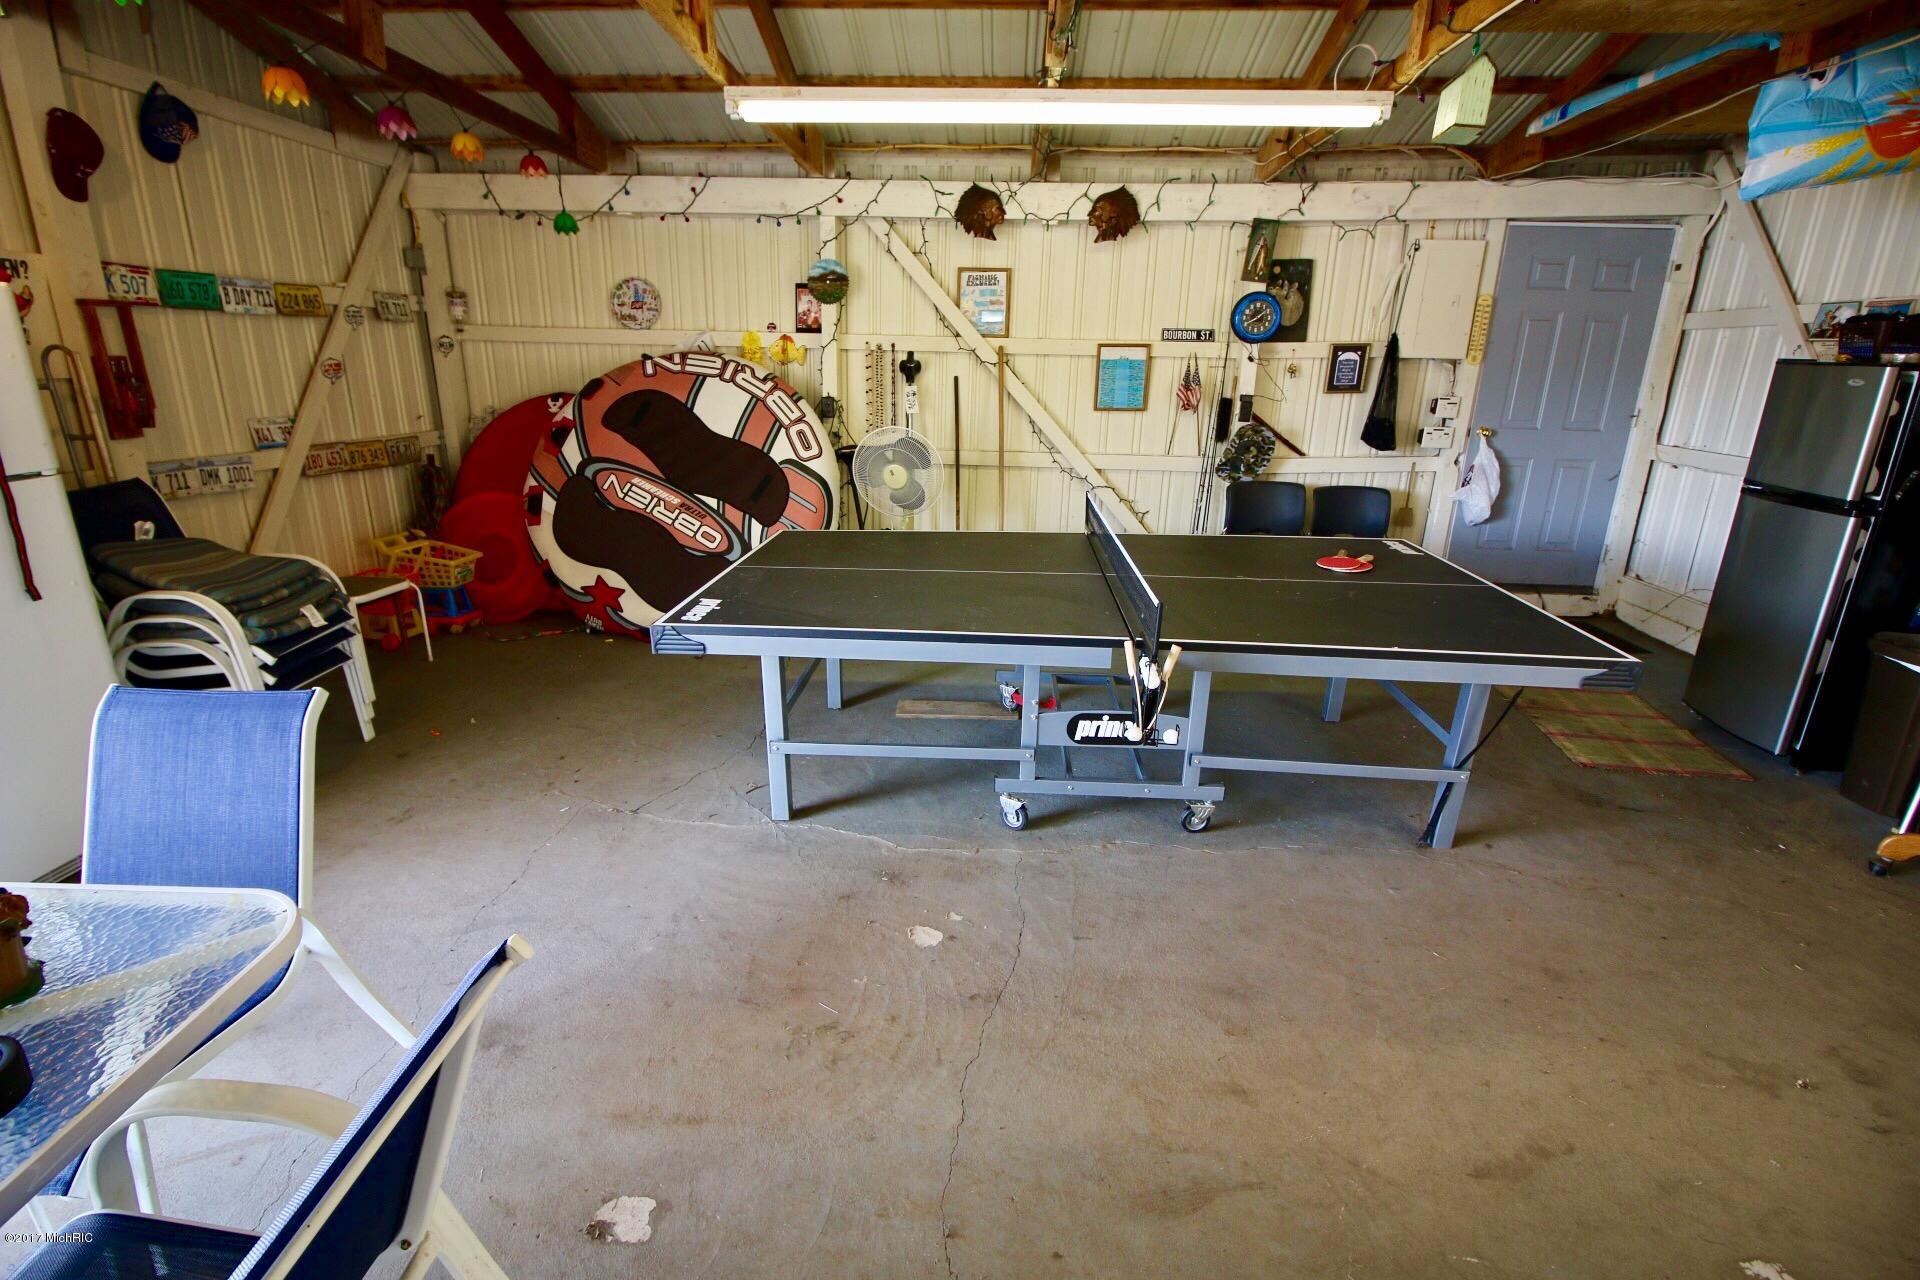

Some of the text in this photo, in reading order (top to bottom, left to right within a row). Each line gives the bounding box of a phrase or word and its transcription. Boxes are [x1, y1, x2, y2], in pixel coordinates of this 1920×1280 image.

[119, 274, 148, 295] 507
[222, 286, 274, 308] B DAY 711
[279, 292, 321, 310] 224 865
[392, 302, 408, 317] 711
[1163, 330, 1213, 340] BOURBON ST.
[165, 471, 191, 491] 711
[200, 465, 254, 486] DMK 1001
[601, 473, 722, 549] OBRIEN
[680, 502, 708, 519] ULTRA
